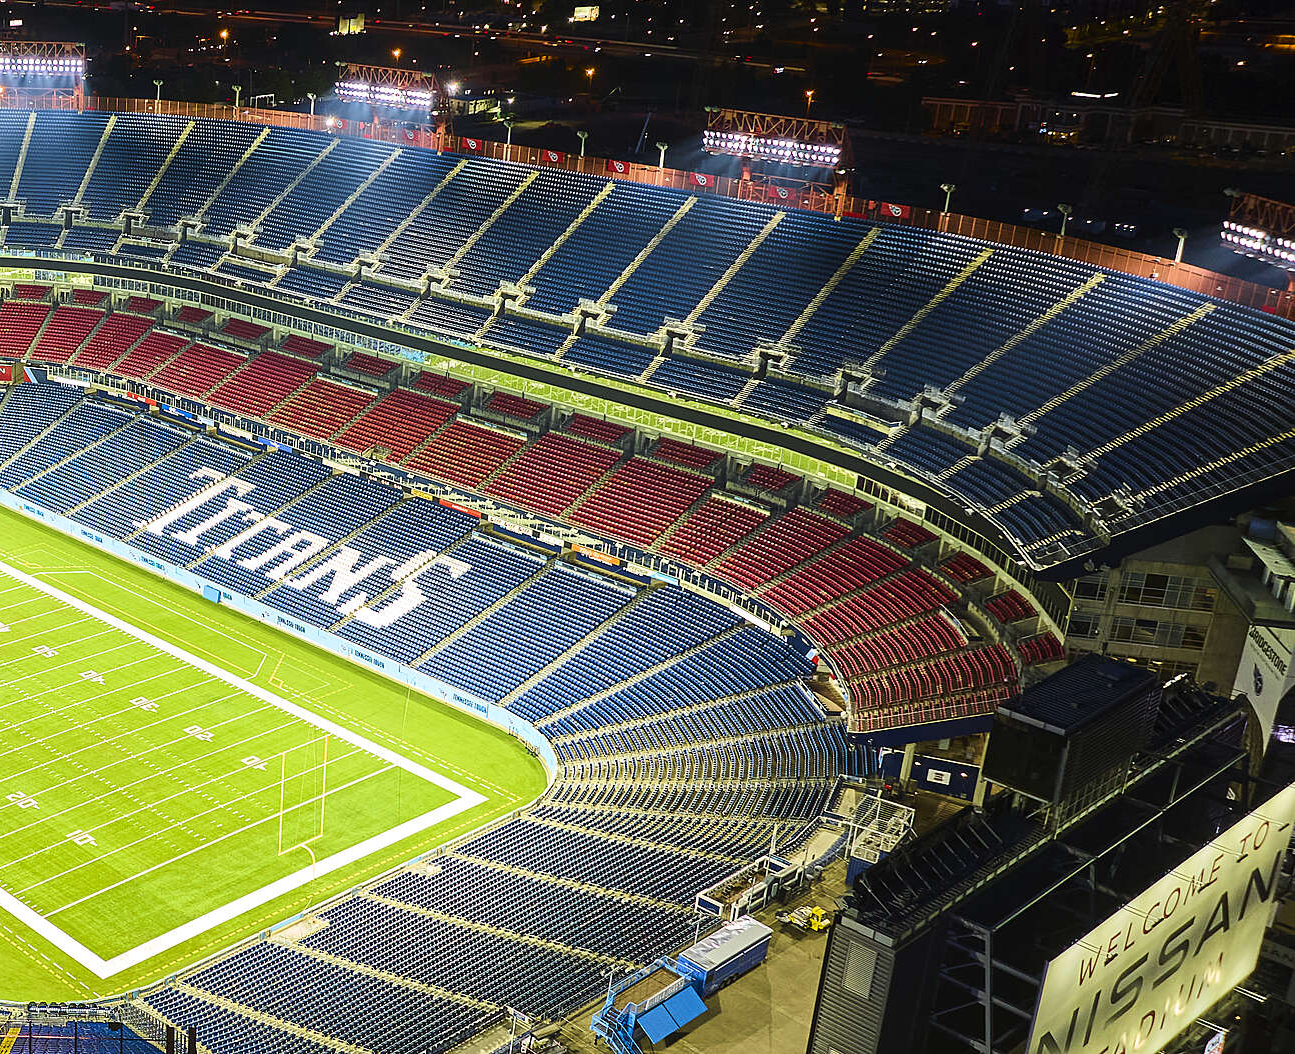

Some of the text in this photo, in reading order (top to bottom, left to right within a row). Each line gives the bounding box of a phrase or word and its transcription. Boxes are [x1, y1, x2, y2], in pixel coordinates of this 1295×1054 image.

[31, 645, 59, 658] 50
[1249, 625, 1287, 676] BRIDGESTONE
[78, 669, 105, 685] 40
[183, 725, 215, 742] 20
[5, 791, 37, 809] 20
[65, 829, 94, 846] 10
[1079, 821, 1270, 986] WELCOME TO
[1037, 850, 1282, 1054] NISSAN
